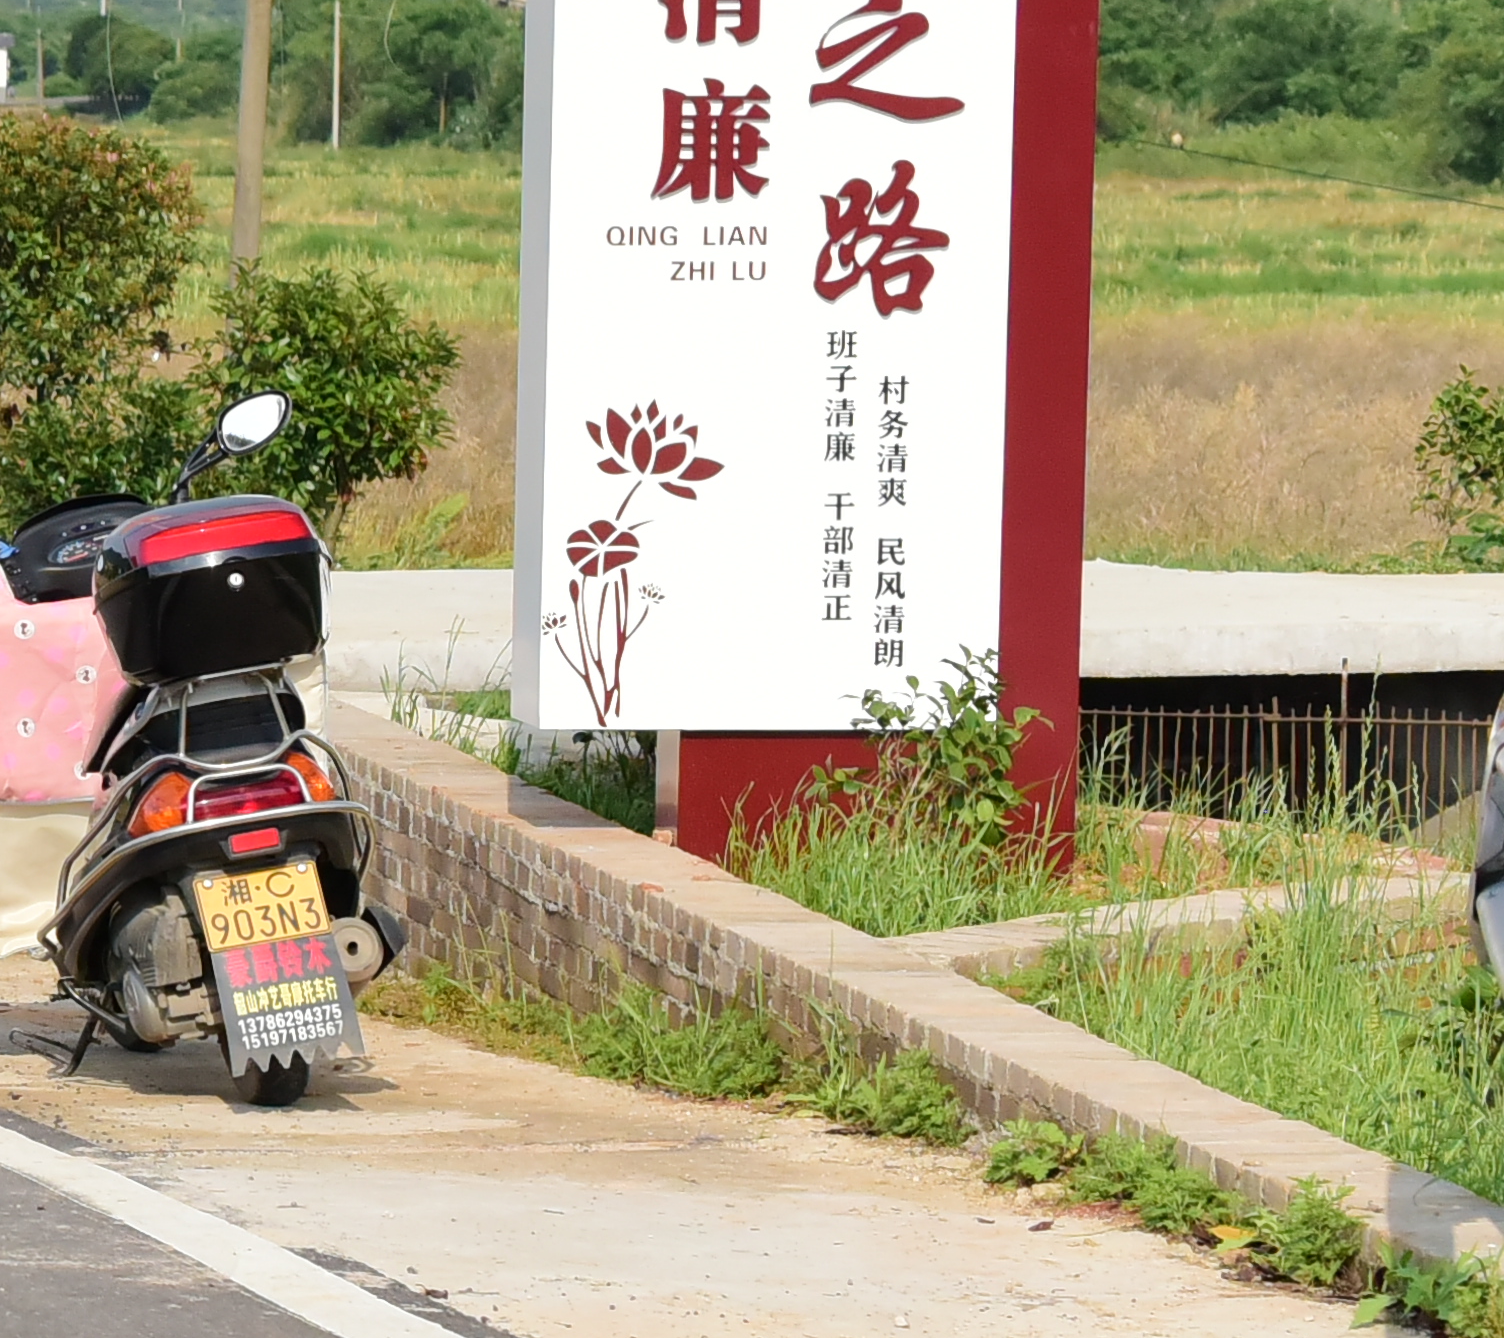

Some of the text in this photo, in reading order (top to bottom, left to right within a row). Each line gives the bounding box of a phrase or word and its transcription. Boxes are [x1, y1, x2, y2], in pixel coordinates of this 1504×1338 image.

[605, 226, 768, 247] QING LIAN
[670, 261, 767, 281] ZHI LU
[821, 330, 858, 622] 班子清廉 干部清正
[873, 375, 910, 668] 村务清爽 民风清朗
[211, 897, 322, 945] 903N3
[237, 1003, 343, 1035] 13786294375
[242, 1019, 344, 1050] 15197183567
